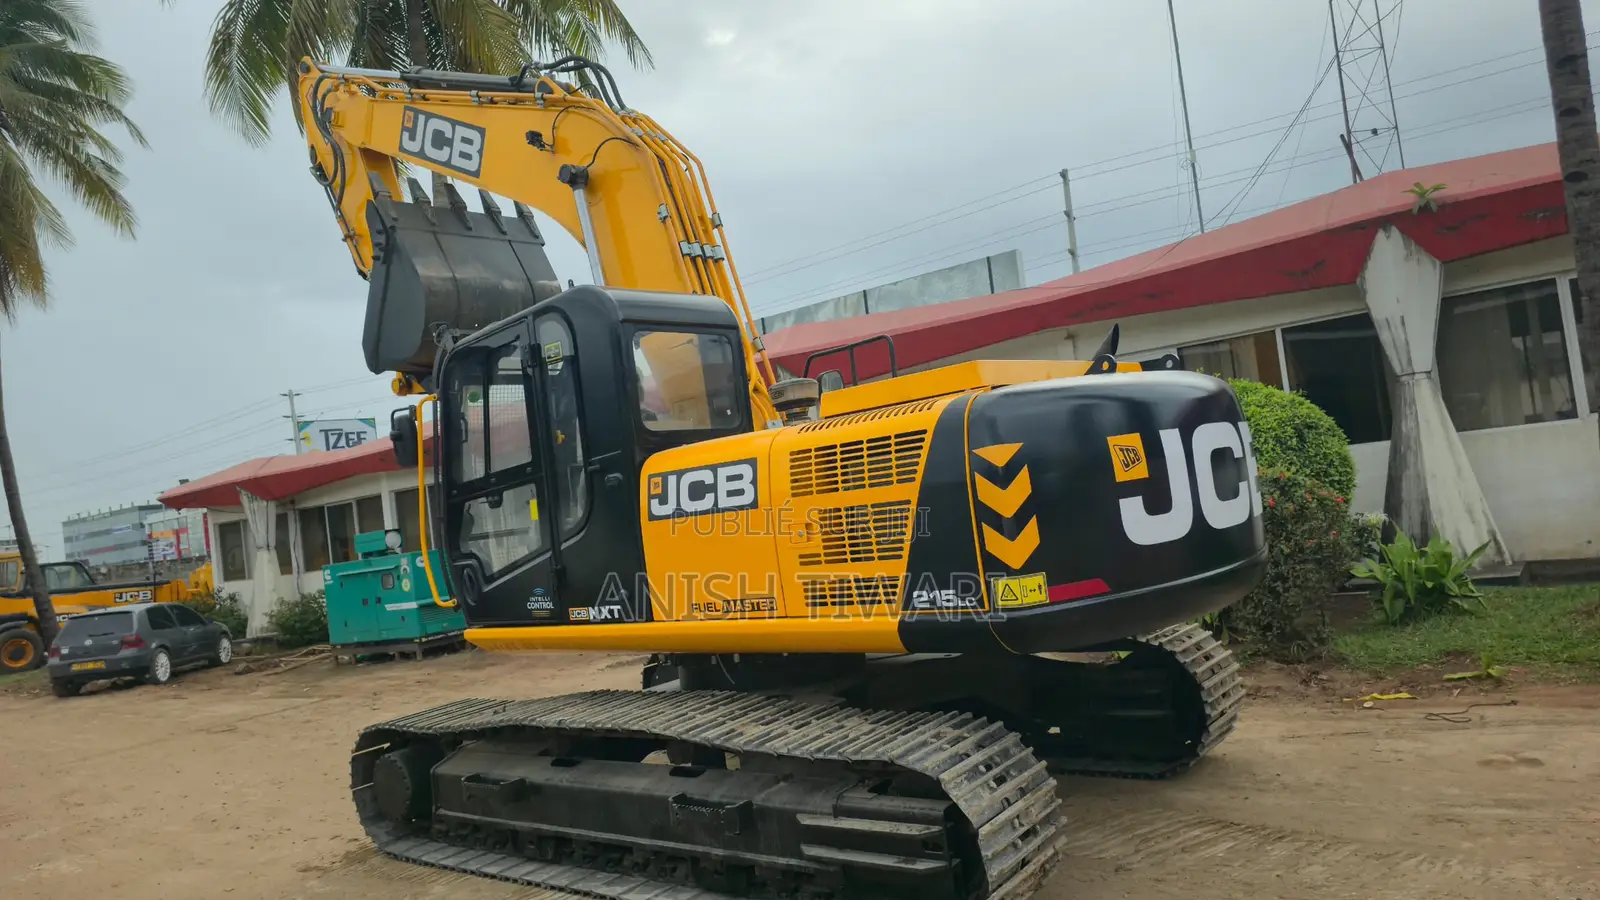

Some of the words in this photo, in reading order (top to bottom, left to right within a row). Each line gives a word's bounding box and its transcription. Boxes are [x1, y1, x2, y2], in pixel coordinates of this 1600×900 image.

[402, 113, 482, 172] JCB
[1118, 447, 1141, 469] JCB
[650, 463, 755, 516] JCB
[115, 590, 152, 602] JCB
[527, 601, 555, 610] CONTROL
[571, 609, 588, 619] JCB
[588, 605, 621, 620] NXT
[691, 603, 721, 613] FUEL
[723, 599, 777, 613] MASTER
